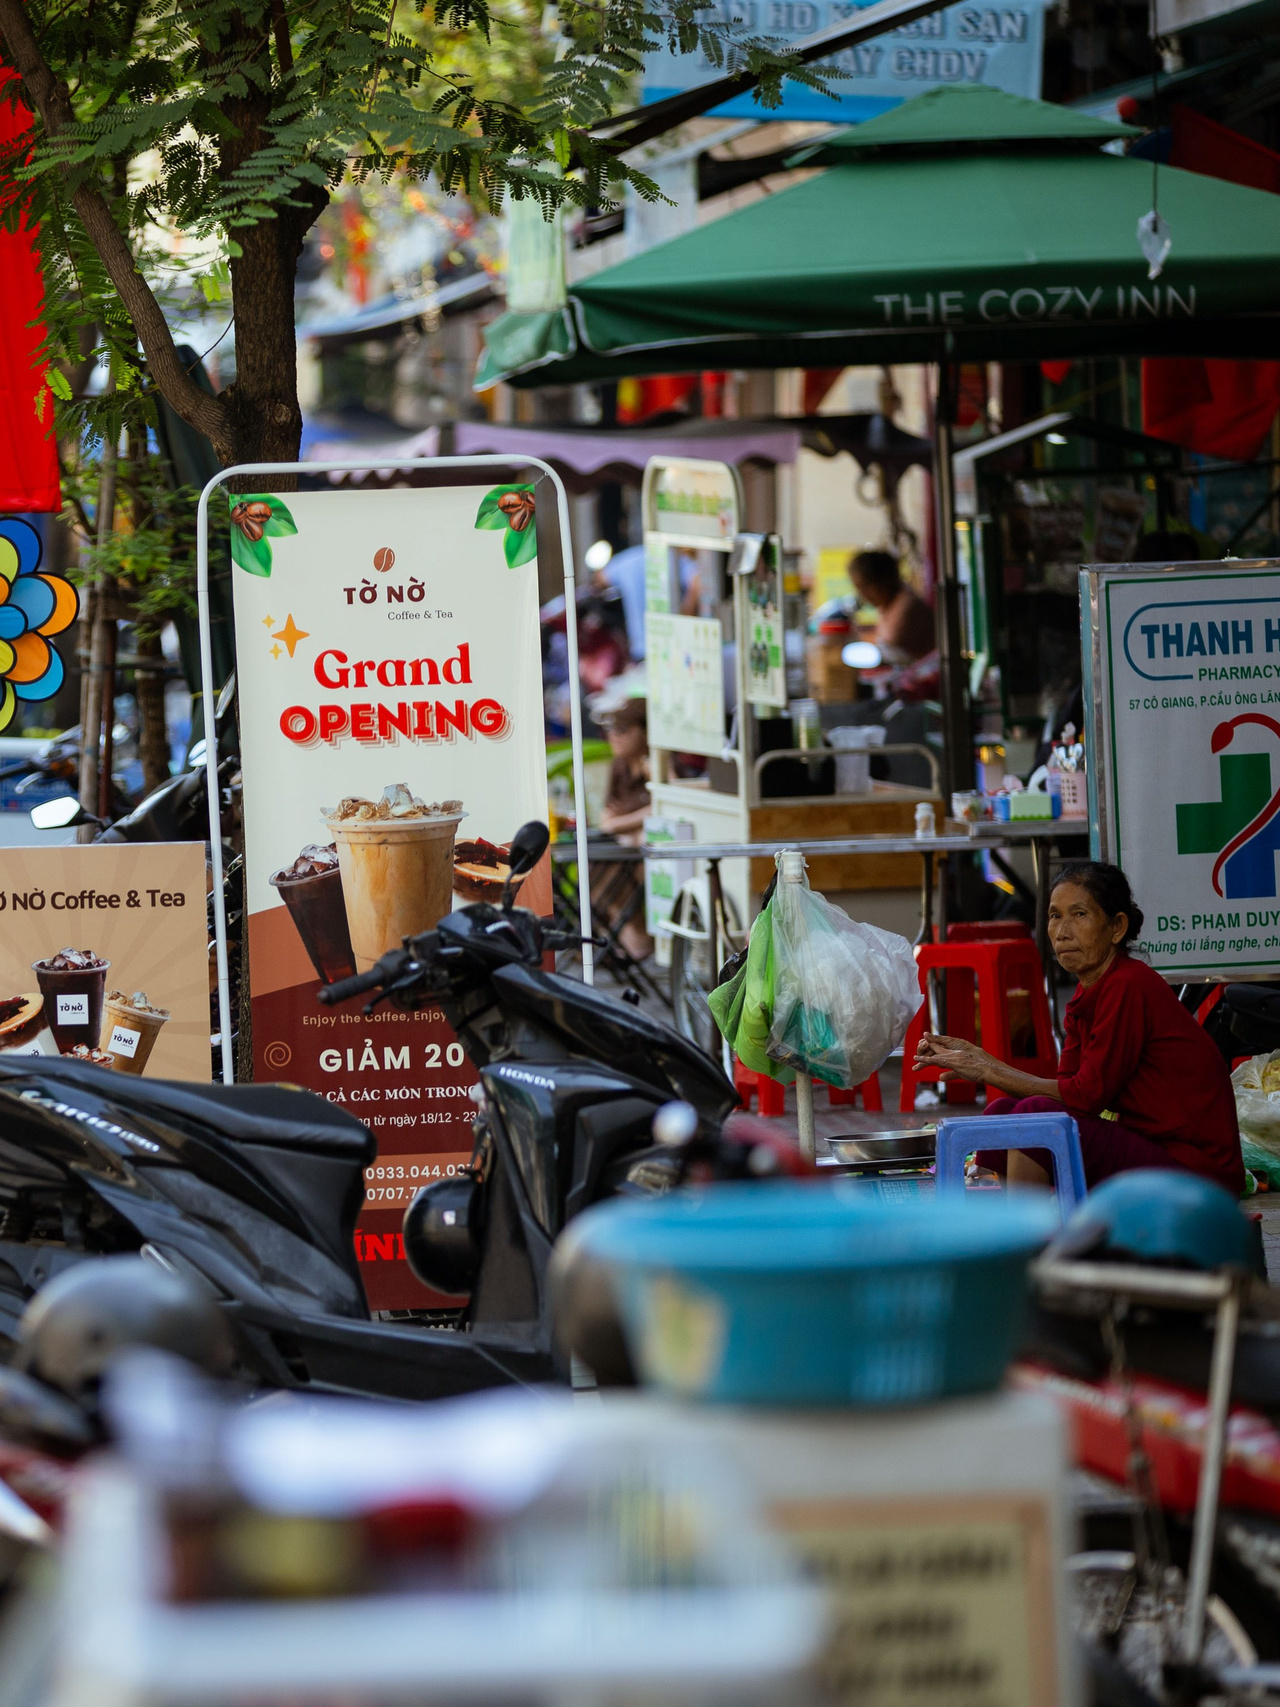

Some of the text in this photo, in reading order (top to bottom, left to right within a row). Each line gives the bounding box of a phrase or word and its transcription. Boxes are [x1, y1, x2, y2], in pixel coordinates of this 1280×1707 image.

[767, 1, 816, 32] HD
[958, 9, 1027, 44] SẠN
[891, 47, 987, 81] CHDV
[873, 284, 1196, 325] THE COZY INN
[343, 576, 426, 605] TỜ NỜ
[387, 610, 453, 621] Coffee & Tea
[1140, 620, 1254, 659] THANH
[313, 642, 473, 689] Grand
[1198, 664, 1280, 681] PHARMACY
[1129, 699, 1140, 710] 57
[1143, 695, 1159, 709] CÔ
[1161, 695, 1198, 709] GIANG,
[1234, 691, 1258, 705] ÔNG
[279, 698, 512, 748] OPENING
[12, 888, 46, 911] NỜ
[50, 890, 121, 910] Coffee
[125, 889, 142, 908] &
[146, 889, 186, 907] Tea
[1157, 910, 1280, 932] DS: PHẠM DUY
[1138, 935, 1280, 955] Chúng tôi lắng nghe, ch
[60, 1002, 83, 1012] TỜ NỜ
[302, 1010, 447, 1027] Enjoy the Coffee, Enjoy
[319, 1038, 465, 1072] GIẢM 20
[499, 1066, 556, 1091] HONDA
[326, 1087, 347, 1103] CẢ
[350, 1086, 381, 1102] CÁC
[385, 1086, 421, 1100] MÓN
[374, 1114, 386, 1126] từ
[389, 1113, 418, 1127] ngày
[420, 1112, 452, 1124] 18/12
[366, 1186, 426, 1200] 0707.7
